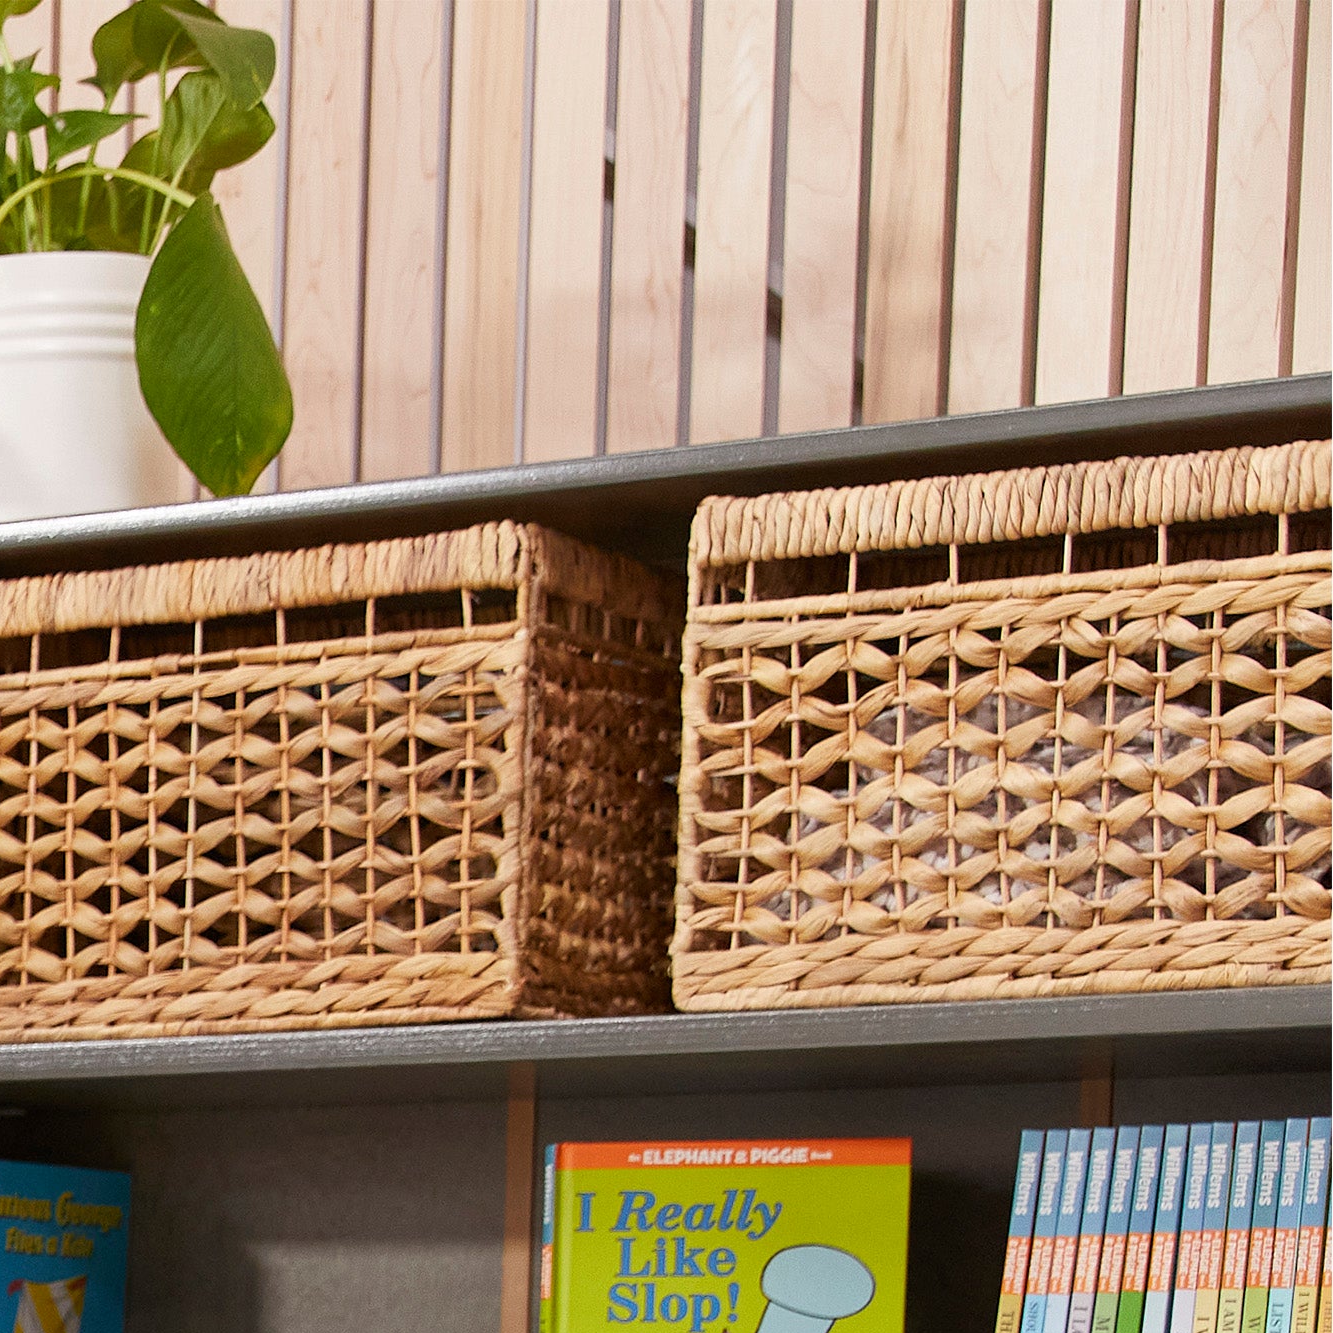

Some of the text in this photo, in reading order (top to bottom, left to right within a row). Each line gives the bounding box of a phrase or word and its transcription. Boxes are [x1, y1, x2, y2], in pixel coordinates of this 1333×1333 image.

[642, 1149, 732, 1165] ELEPHANT
[735, 1149, 746, 1164] &
[749, 1147, 809, 1164] PIGGIE
[1015, 1152, 1037, 1216] Willems
[1040, 1152, 1061, 1215] Willems
[1062, 1152, 1083, 1214] Willems
[1087, 1150, 1108, 1213] Willems
[1111, 1149, 1133, 1213] Willems
[1135, 1147, 1157, 1211] Willems
[1161, 1147, 1182, 1211] Willems
[1188, 1145, 1208, 1209] Willems
[1207, 1144, 1227, 1208] Willems
[1234, 1143, 1253, 1208] Willems
[1259, 1141, 1280, 1206] Willems
[1281, 1142, 1301, 1206] Willems
[1306, 1139, 1325, 1204] Willems
[575, 1188, 783, 1240] I Really
[46, 1237, 57, 1256] a
[615, 1237, 737, 1278] Like
[607, 1282, 740, 1333] Slop!
[1221, 1309, 1236, 1331] AM
